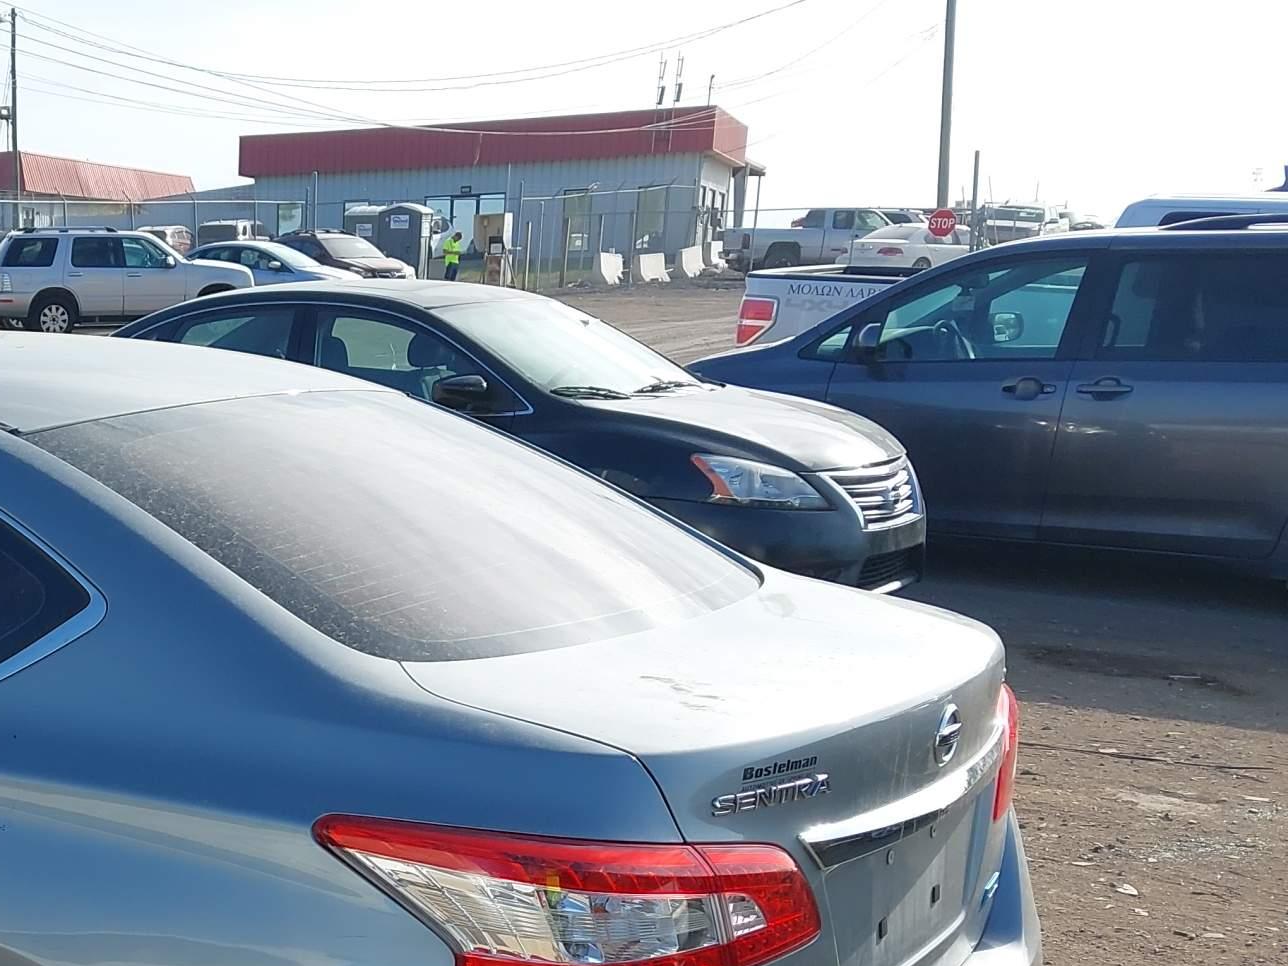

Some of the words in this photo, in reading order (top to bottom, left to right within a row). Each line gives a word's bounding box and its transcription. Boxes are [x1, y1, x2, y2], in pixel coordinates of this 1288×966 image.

[930, 217, 955, 229] STOP
[742, 755, 818, 781] Bostelman
[711, 773, 832, 817] SENTRA
